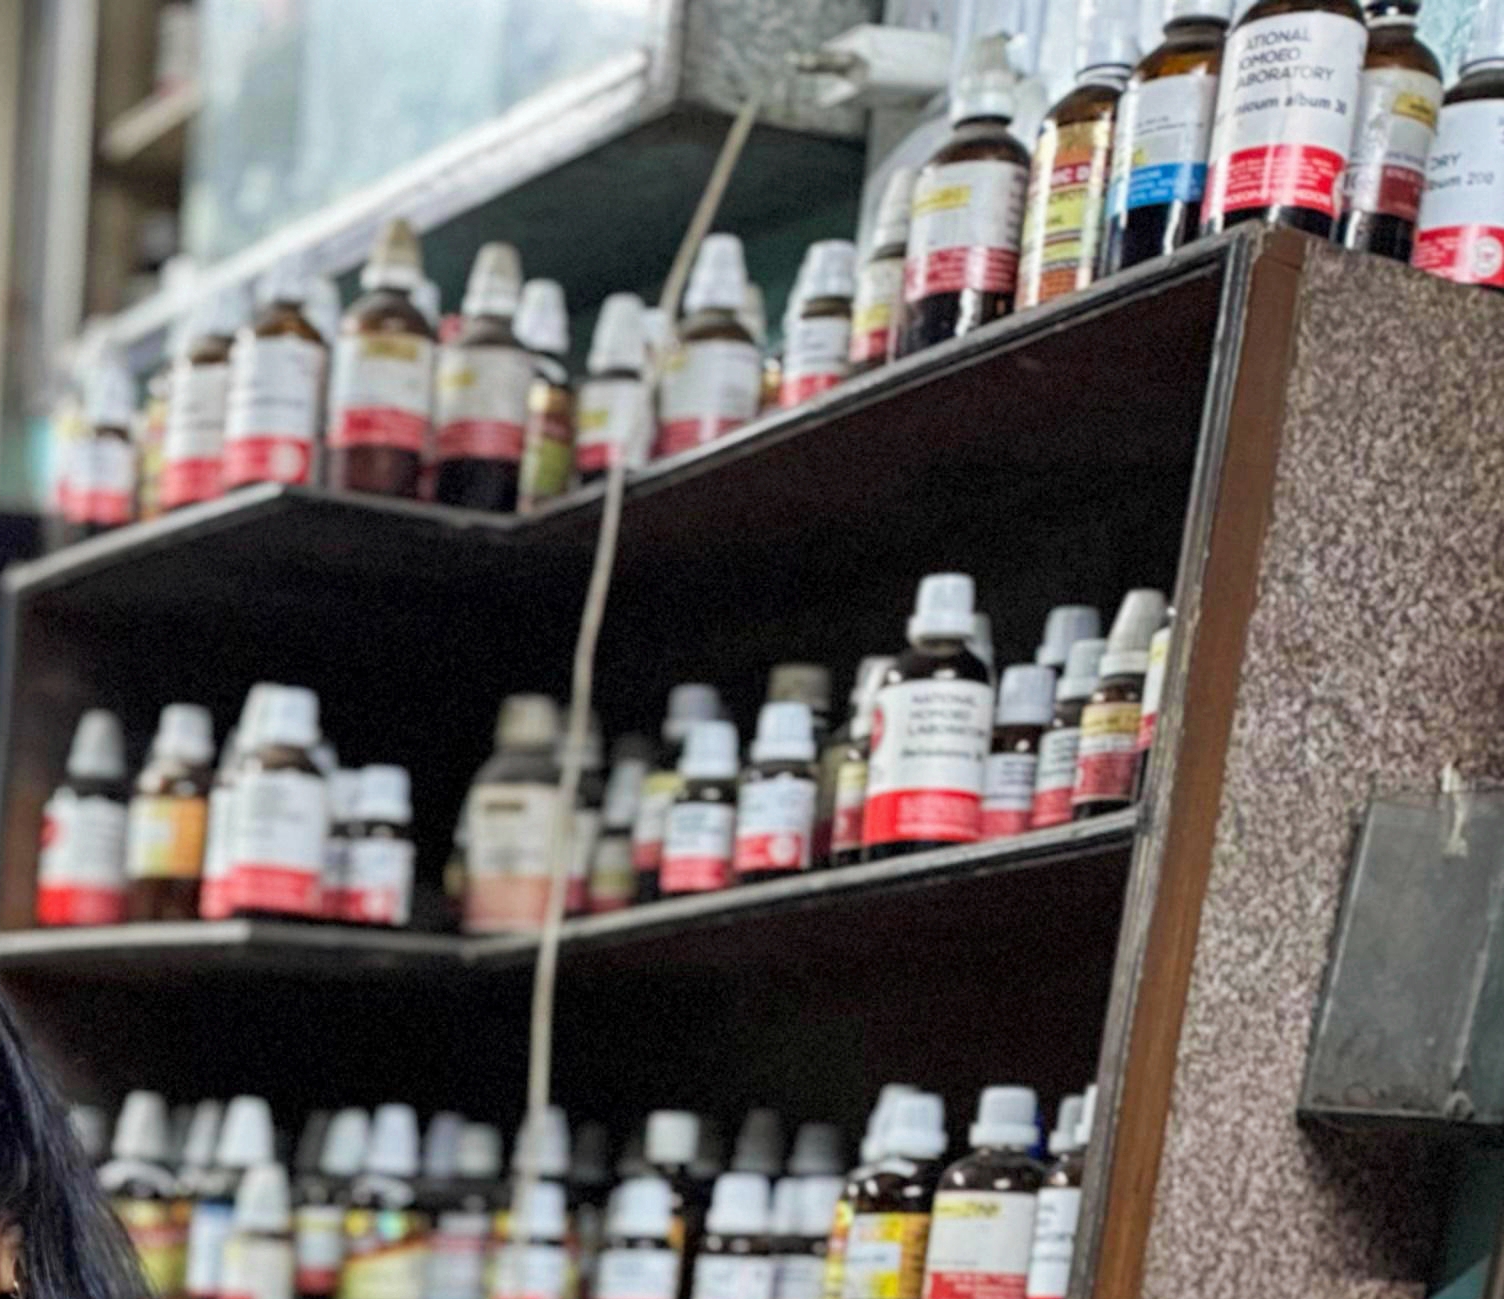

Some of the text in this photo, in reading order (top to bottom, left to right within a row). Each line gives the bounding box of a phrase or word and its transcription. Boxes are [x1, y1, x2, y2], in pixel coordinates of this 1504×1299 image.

[1245, 26, 1312, 50] ATIONAL
[1238, 46, 1301, 70] OMOEO
[1234, 65, 1335, 91] ABORATORY
